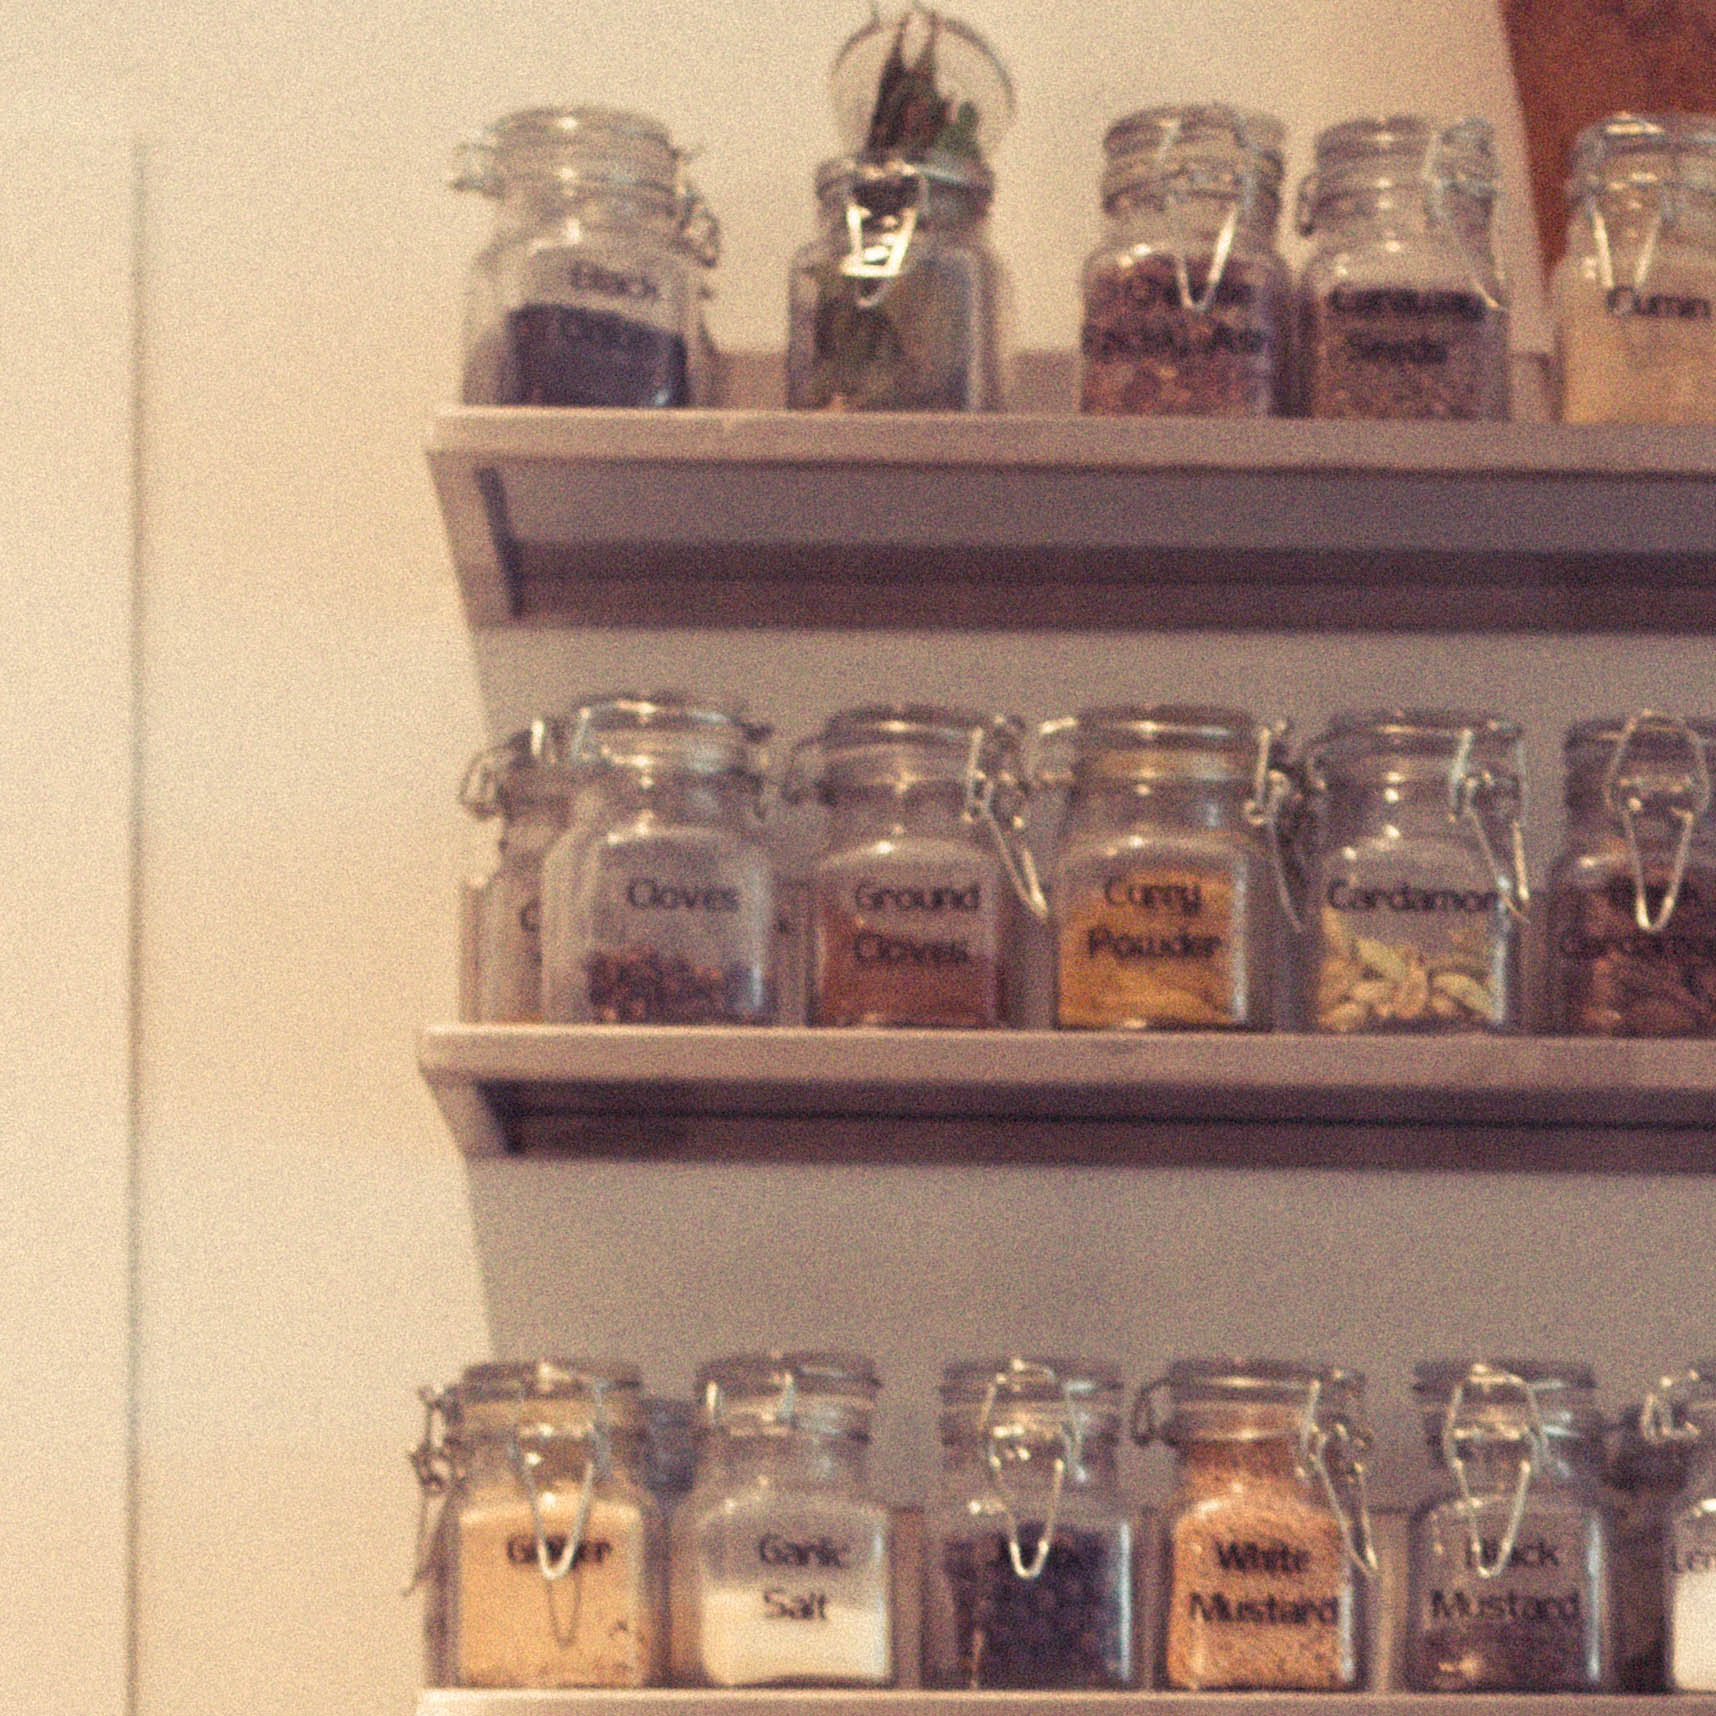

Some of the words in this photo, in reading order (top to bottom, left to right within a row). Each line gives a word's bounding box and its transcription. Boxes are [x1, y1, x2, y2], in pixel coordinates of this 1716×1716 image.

[1605, 284, 1712, 319] Cumin
[624, 876, 741, 912] Cloves
[853, 880, 981, 914] Ground
[1104, 873, 1206, 919] Curry
[852, 930, 970, 968] Cloves
[1087, 926, 1223, 961] Powder
[756, 1530, 852, 1569] Garlic
[1214, 1540, 1310, 1575] White
[763, 1587, 828, 1621] Salt
[1188, 1591, 1340, 1624] Mustard
[1431, 1588, 1582, 1621] Mustard
